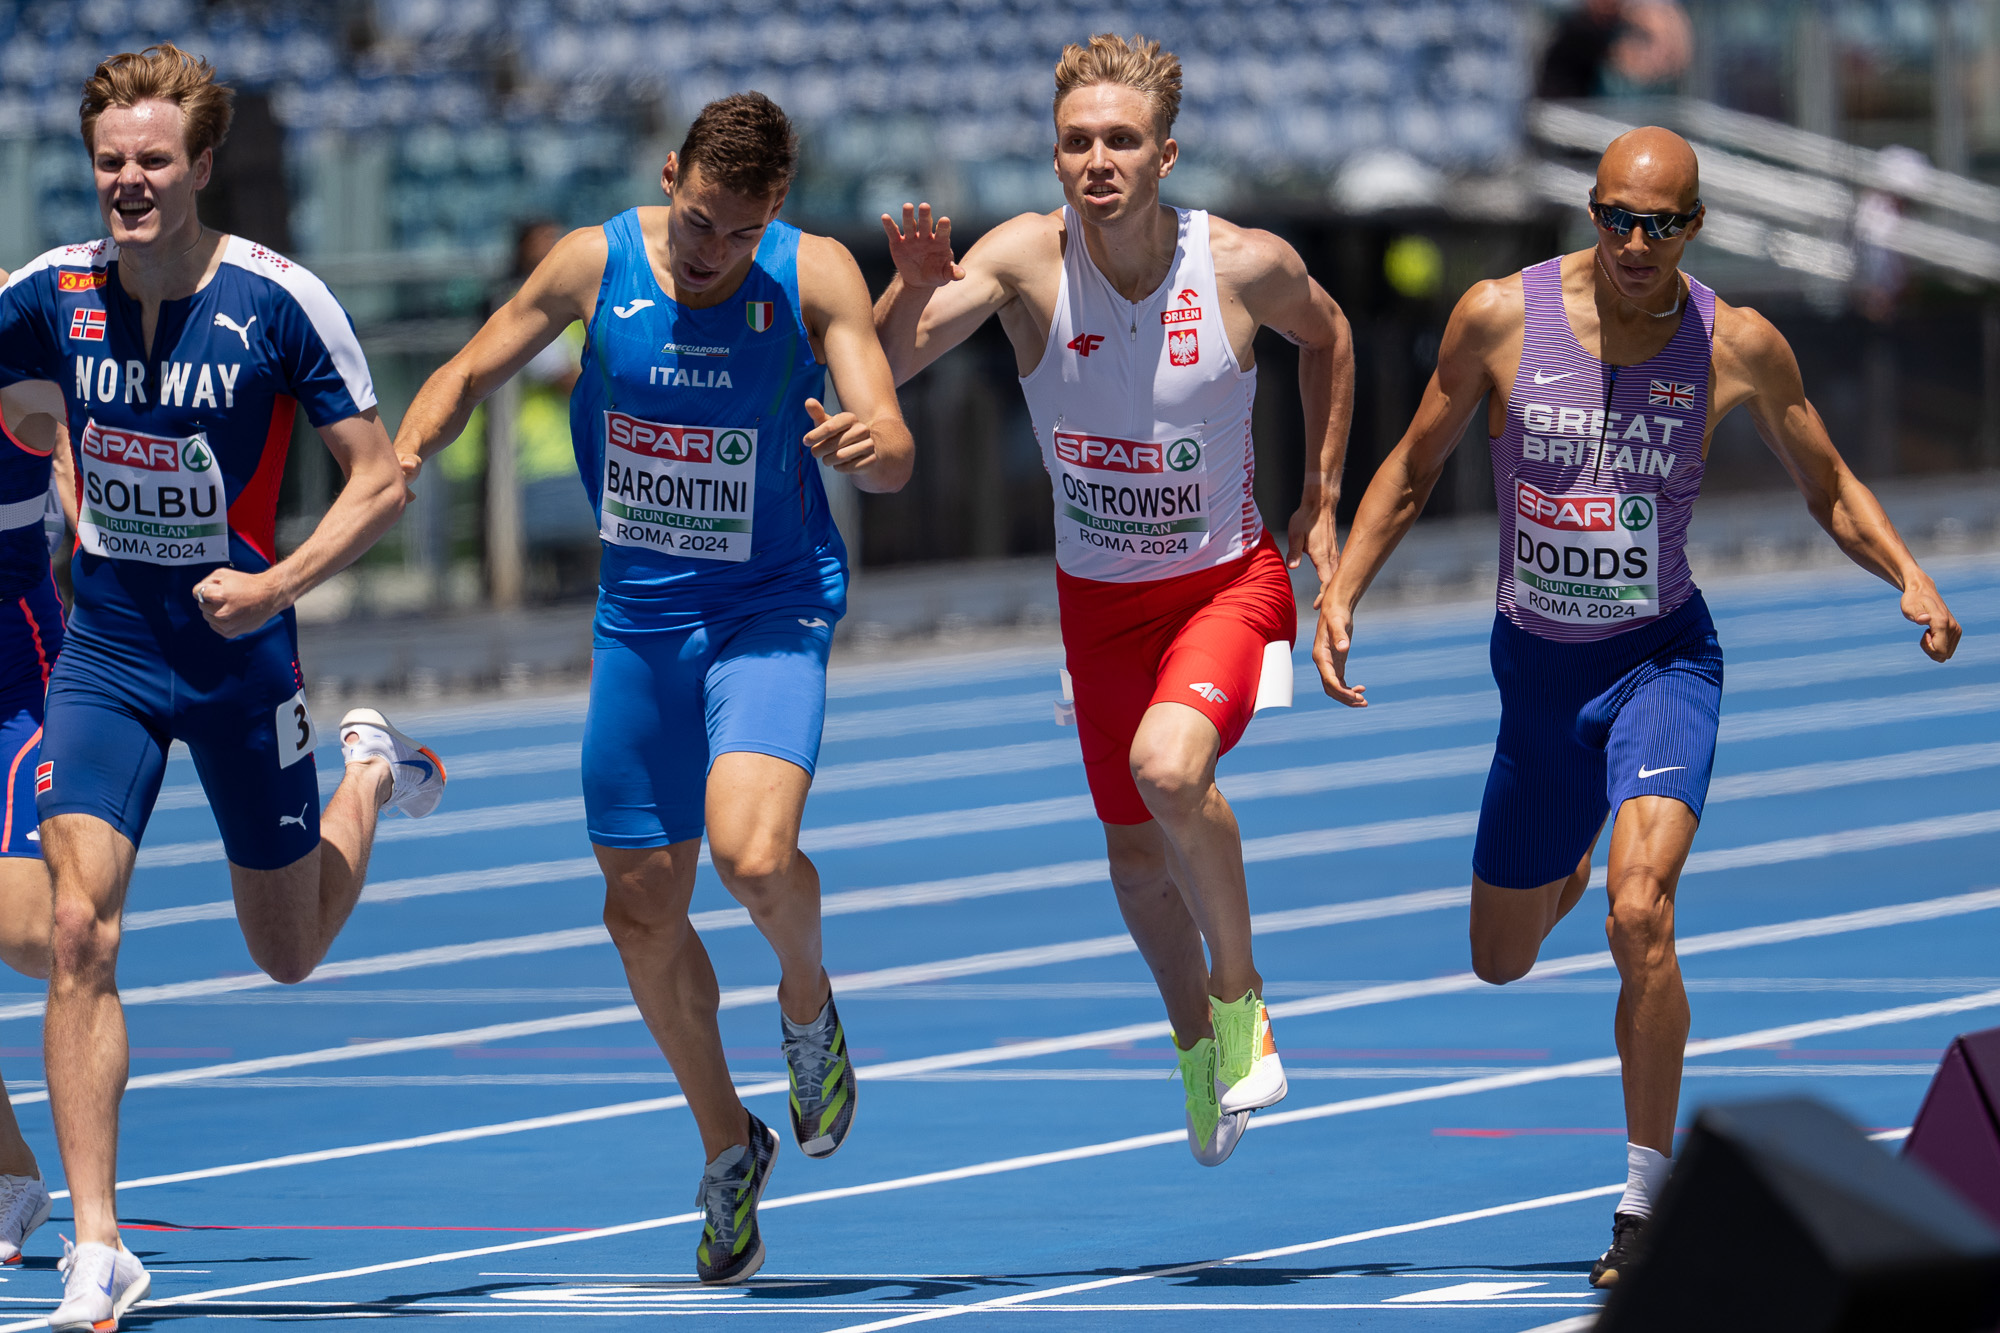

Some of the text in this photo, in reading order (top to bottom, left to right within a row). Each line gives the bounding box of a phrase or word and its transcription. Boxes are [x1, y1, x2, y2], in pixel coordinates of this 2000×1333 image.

[79, 275, 107, 288] EXTRA
[1163, 309, 1200, 324] ORLEN
[663, 342, 730, 354] FRECCIAROSSA
[1067, 333, 1105, 357] 4F
[649, 366, 733, 389] ITALIA
[1523, 402, 1683, 445] GREAT
[84, 429, 177, 468] SPAR
[610, 418, 709, 459] SPAR
[1056, 438, 1161, 469] SPAR
[1522, 434, 1677, 479] BRITAIN
[87, 471, 218, 518] SOLBU
[607, 460, 747, 513] BARONTINI
[1062, 473, 1201, 518] OSTROWSKI
[633, 509, 664, 523] RUN
[1519, 489, 1612, 527] SPAR
[110, 518, 139, 533] RUN
[616, 522, 729, 553] ROMA 2024
[1092, 517, 1121, 532] RUN
[98, 532, 206, 559] ROMA 2024
[1080, 527, 1189, 555] ROMA 2024
[1517, 529, 1648, 580] DODDS
[1541, 579, 1569, 594] RUN
[1529, 591, 1637, 619] ROMA 2024
[294, 703, 310, 751] 3
